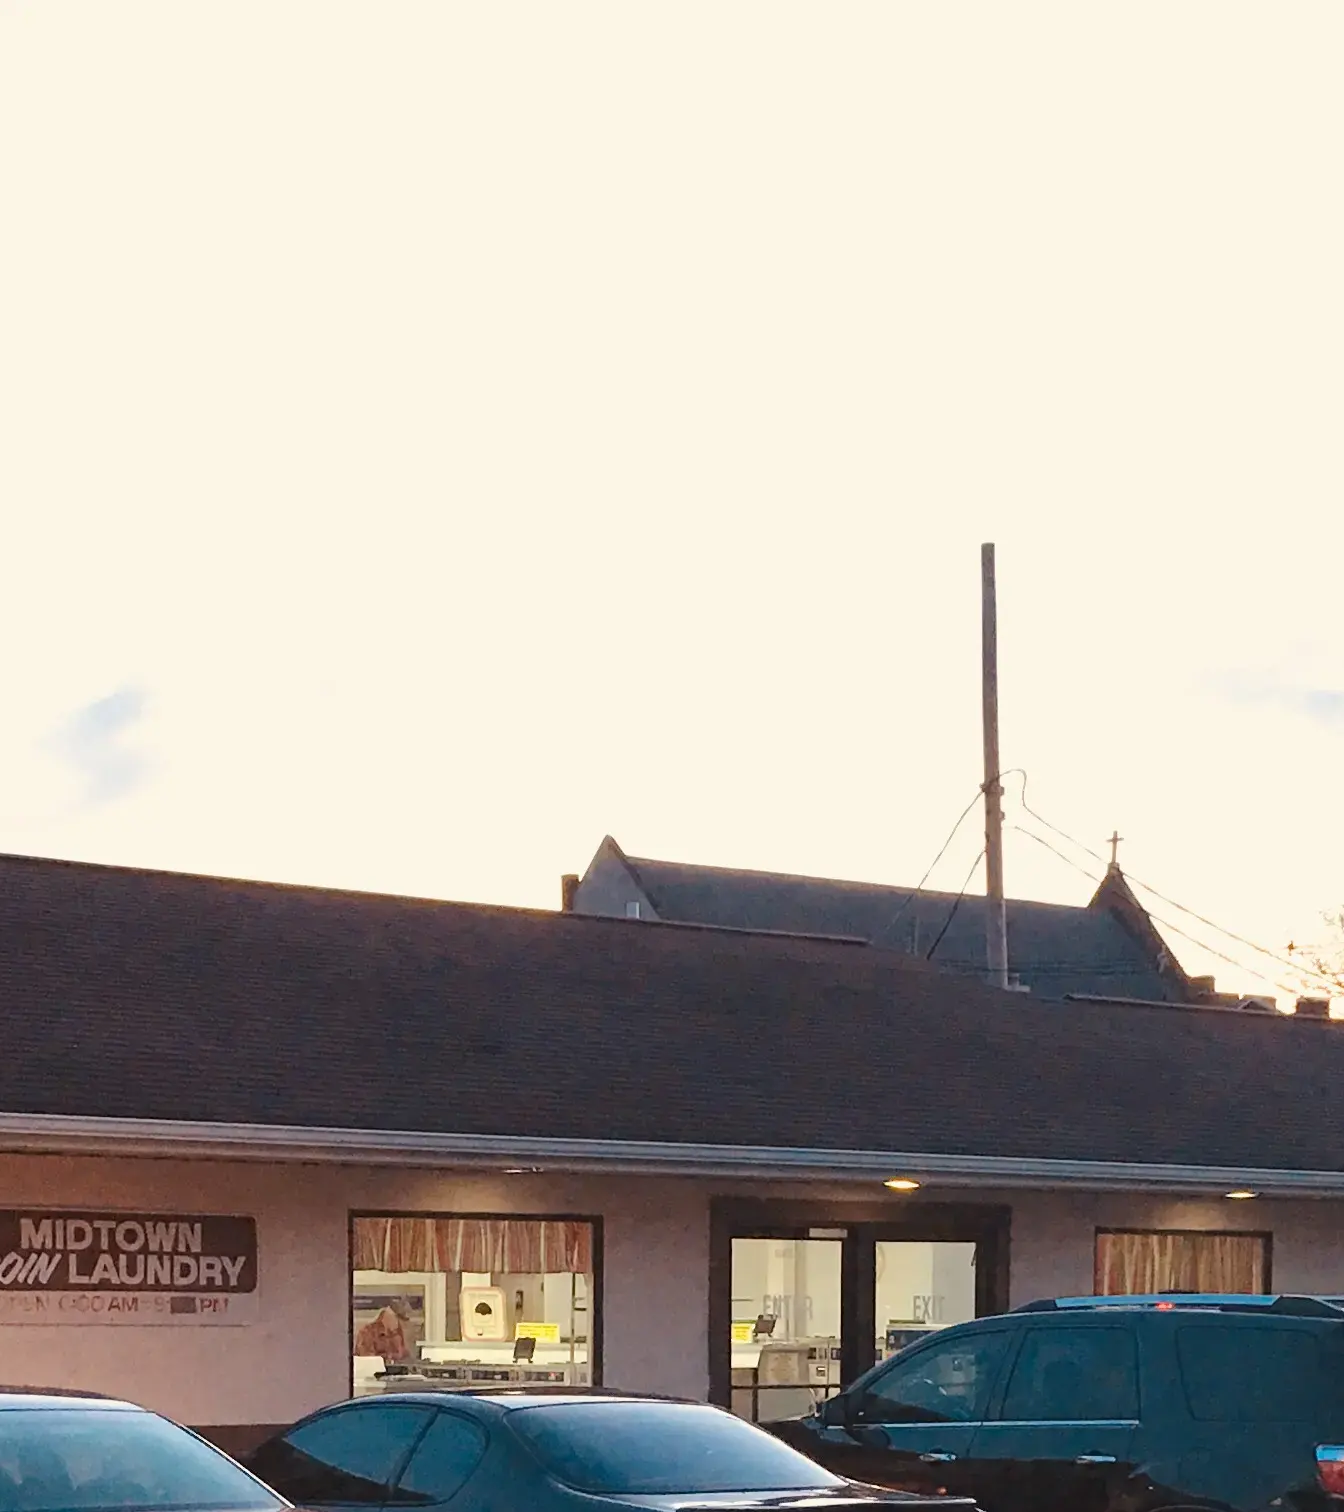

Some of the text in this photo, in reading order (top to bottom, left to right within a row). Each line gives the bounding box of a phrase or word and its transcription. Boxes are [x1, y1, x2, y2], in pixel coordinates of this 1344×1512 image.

[19, 1218, 203, 1252] MIDTOWN
[67, 1253, 247, 1287] LAUNDRY
[762, 1294, 814, 1321] ENTR
[913, 1295, 946, 1321] EXIT
